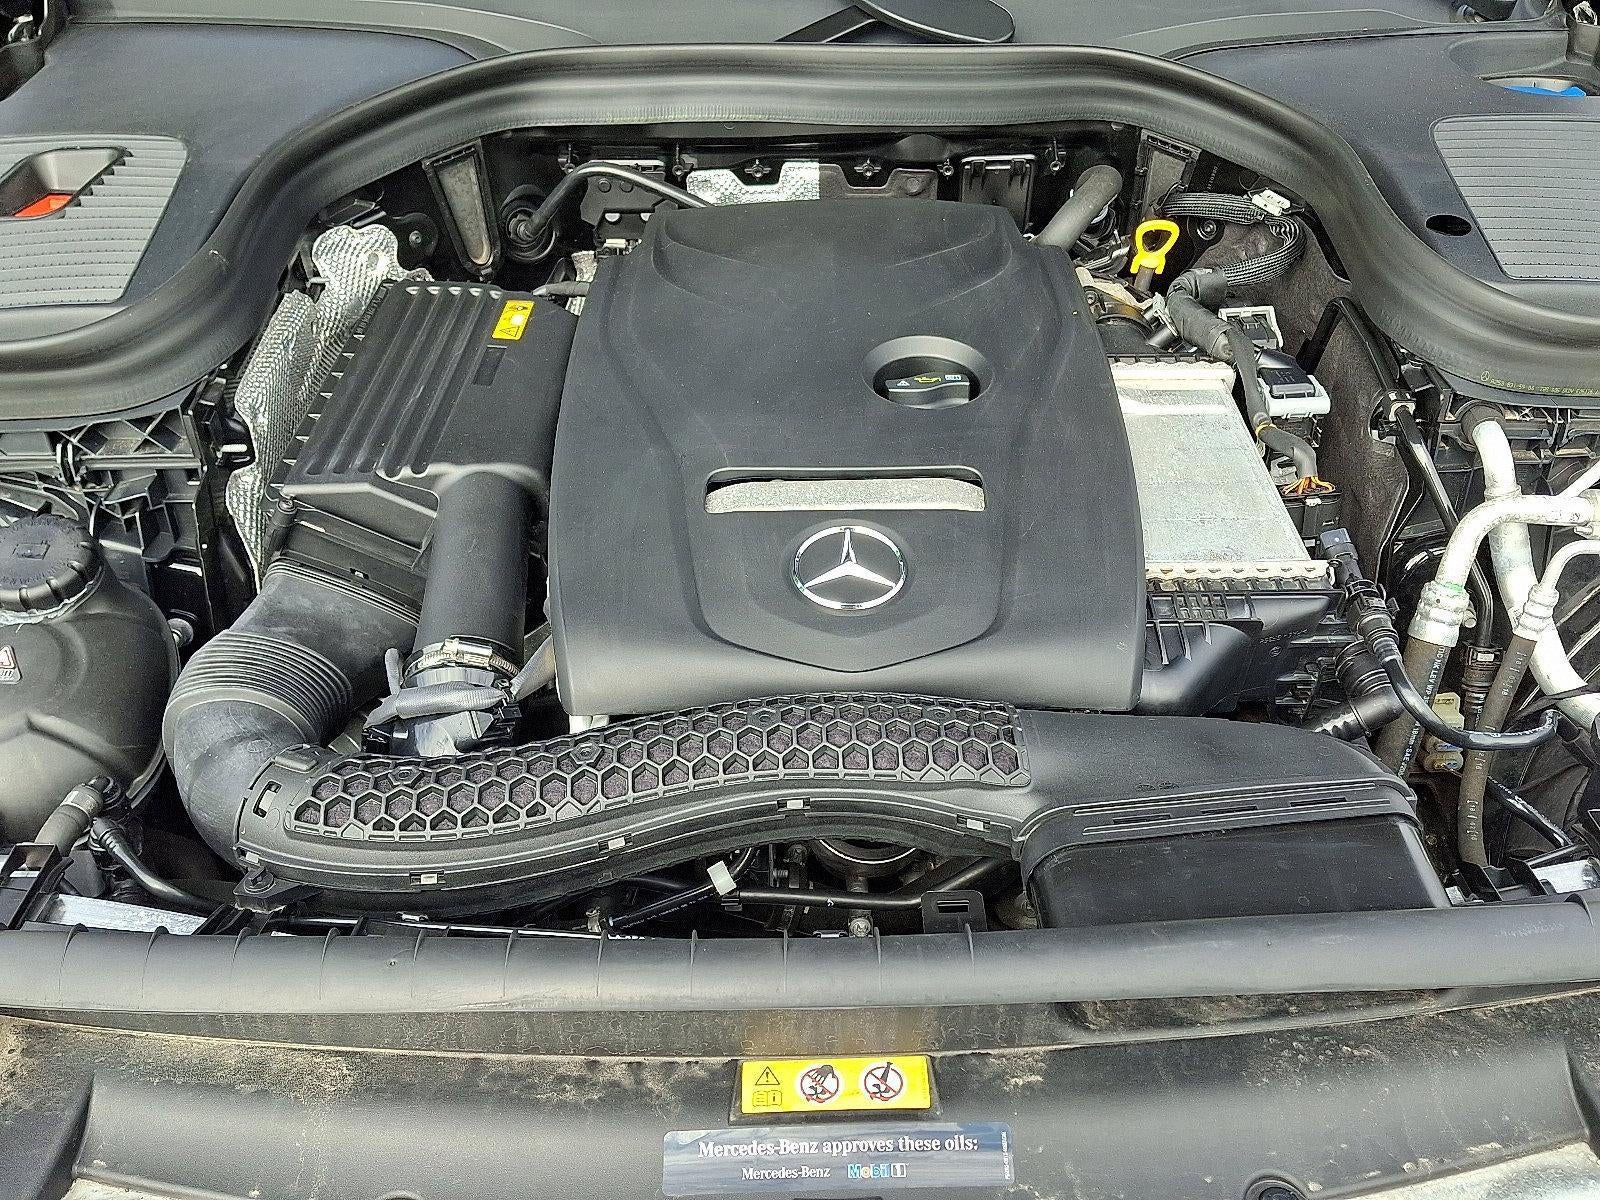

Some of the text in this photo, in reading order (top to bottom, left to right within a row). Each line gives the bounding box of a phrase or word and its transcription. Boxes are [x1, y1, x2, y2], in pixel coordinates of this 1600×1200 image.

[1403, 747, 1413, 761] SAE
[698, 1134, 979, 1158] Mercedes-Benz approves these oils:
[741, 1166, 831, 1180] Mercedes-Benz
[847, 1164, 890, 1179] Mobil
